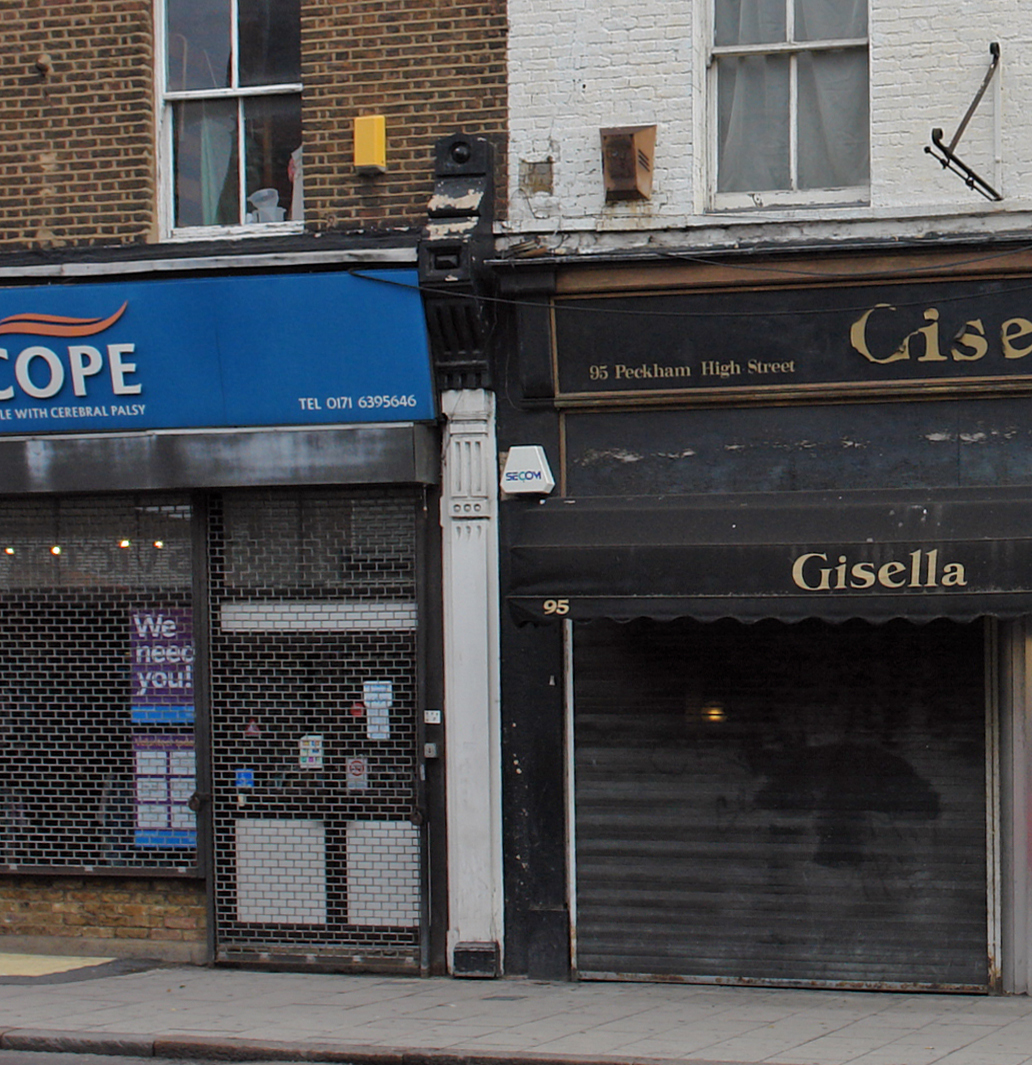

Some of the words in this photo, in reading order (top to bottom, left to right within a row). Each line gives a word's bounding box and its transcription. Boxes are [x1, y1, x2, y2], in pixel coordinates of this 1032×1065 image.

[589, 364, 609, 381] 95
[614, 364, 691, 380] Peckham
[701, 360, 741, 378] High
[747, 359, 796, 374] Street
[14, 408, 48, 420] WITH
[50, 405, 109, 419] CEREBRAL
[111, 404, 146, 417] PALSY
[298, 397, 322, 411] TEL
[326, 396, 353, 410] 0171
[358, 394, 417, 409] 6395646
[505, 471, 542, 482] SECOM
[791, 548, 968, 591] Gisella
[543, 599, 570, 615] 95
[133, 613, 177, 638] We
[136, 665, 192, 696] you!
